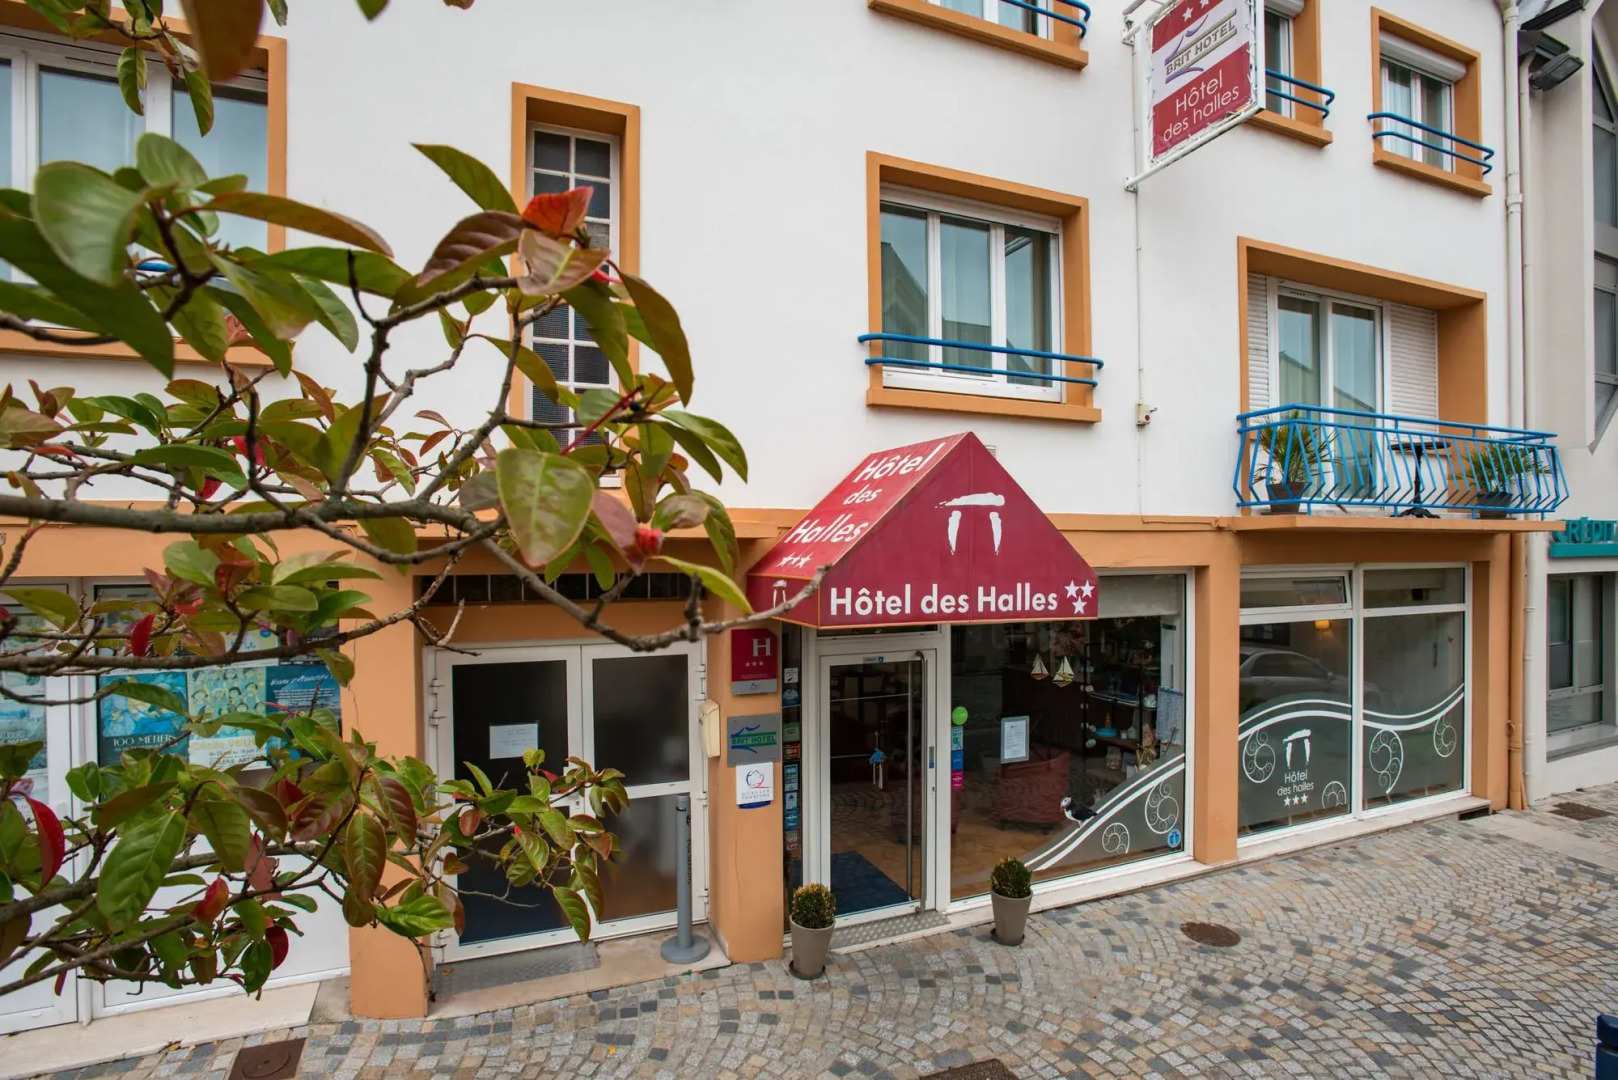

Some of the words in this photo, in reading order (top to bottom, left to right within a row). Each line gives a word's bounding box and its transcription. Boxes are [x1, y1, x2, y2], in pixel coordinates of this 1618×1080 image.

[1165, 50, 1192, 76] BRIT
[1194, 20, 1236, 56] HOTEL
[1175, 69, 1223, 117] Hôtel
[1163, 118, 1189, 142] des
[1193, 85, 1239, 124] halles
[852, 442, 946, 484] Hôtel
[842, 484, 883, 506] des
[783, 513, 869, 545] Halles
[830, 583, 912, 617] Hôtel
[920, 583, 970, 614] des
[977, 582, 1058, 613] Halles
[751, 637, 772, 657] H
[731, 737, 750, 745] BRIT
[751, 736, 776, 744] HOTEL
[1277, 785, 1291, 796] des
[1292, 781, 1314, 793] halles
[1284, 769, 1308, 783] Hôtel
